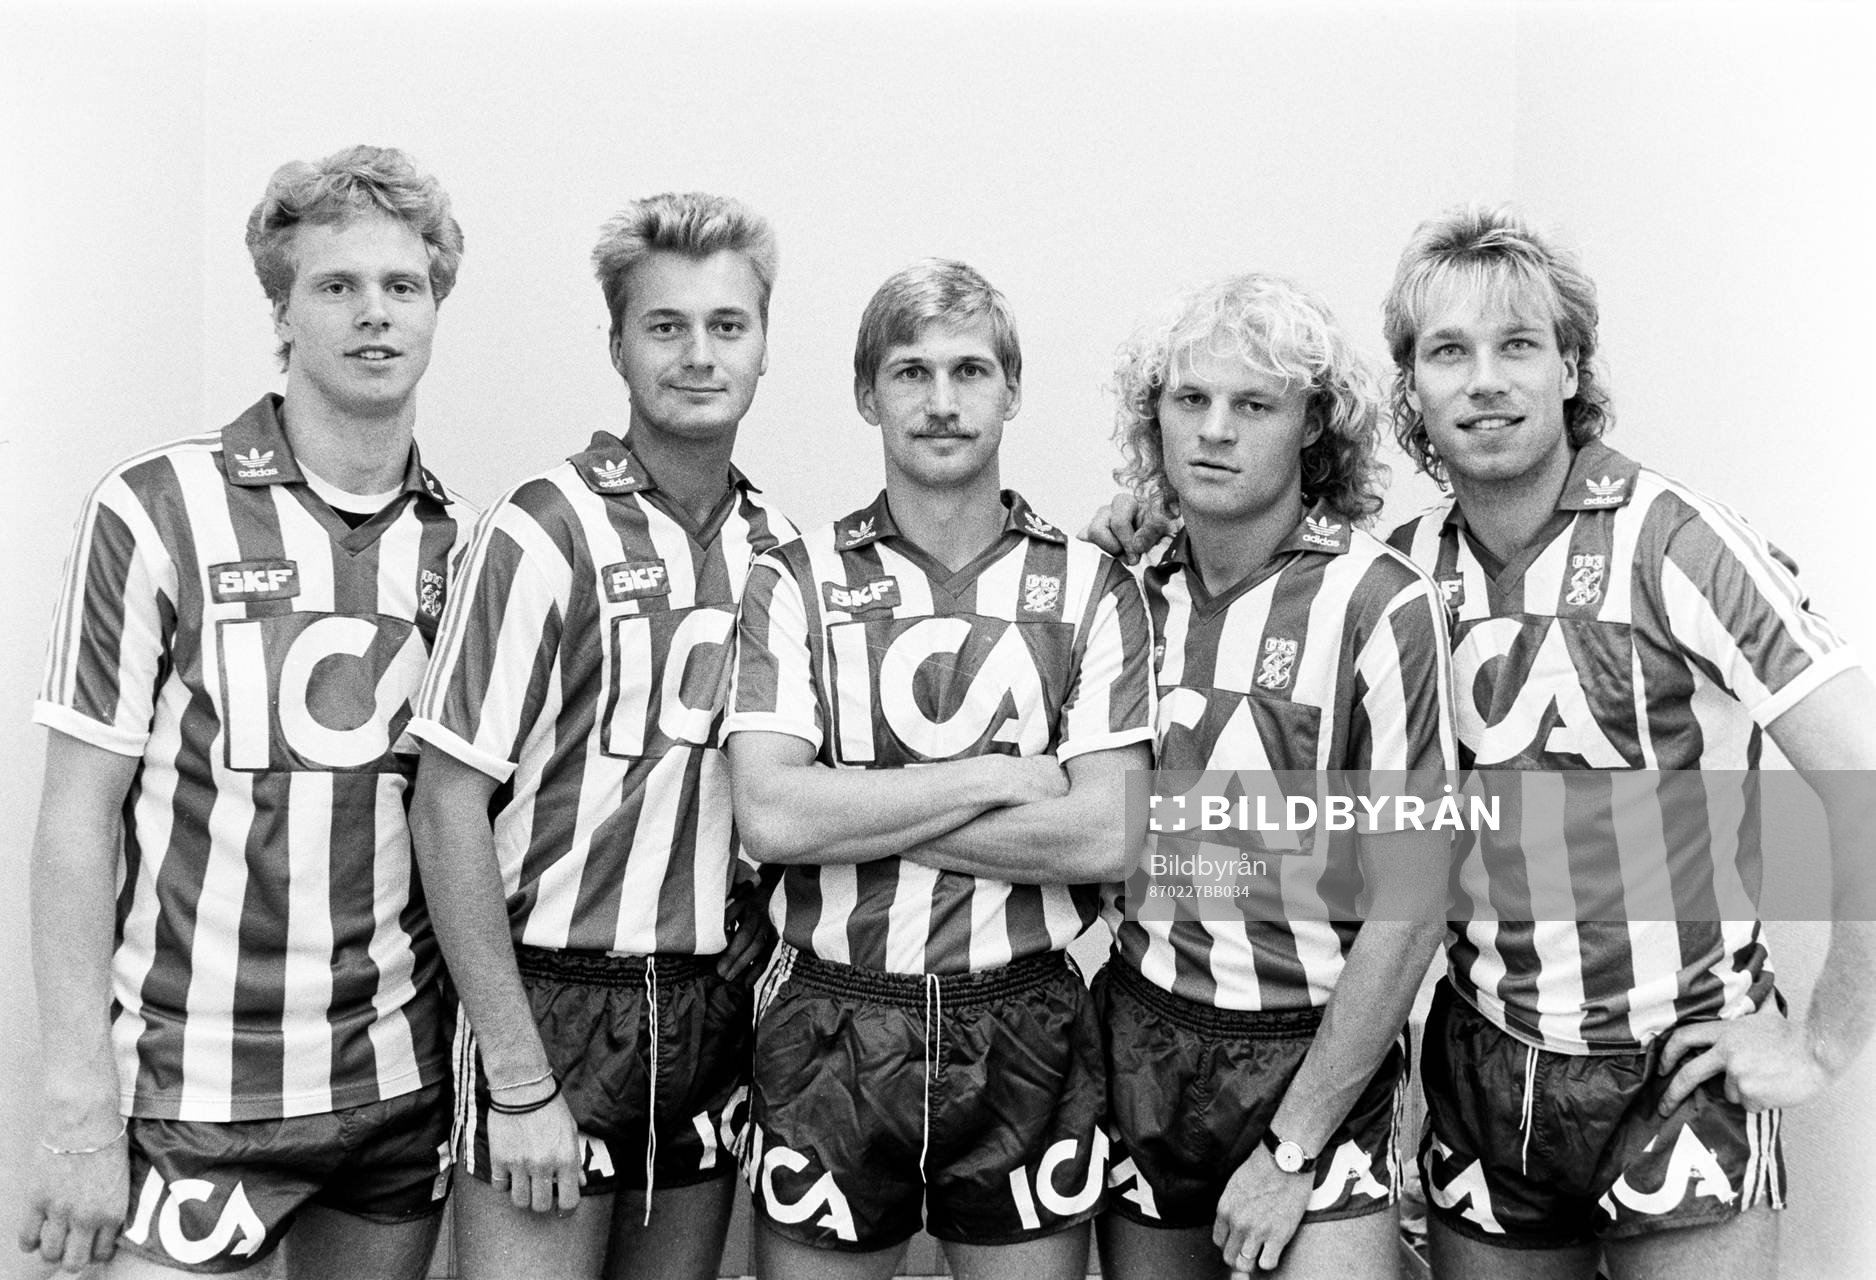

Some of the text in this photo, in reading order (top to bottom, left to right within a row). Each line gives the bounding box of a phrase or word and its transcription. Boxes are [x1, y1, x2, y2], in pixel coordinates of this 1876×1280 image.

[238, 466, 278, 477] adidas
[599, 476, 635, 488] adidas
[1584, 496, 1623, 505] adidas
[1303, 533, 1340, 547] adidas
[217, 569, 293, 594] SKF
[612, 565, 664, 594] SKF
[830, 580, 893, 607] SKF
[608, 608, 736, 757] IC
[831, 618, 1051, 758] ICA
[1452, 617, 1632, 769] CA
[125, 1165, 266, 1264] ICA
